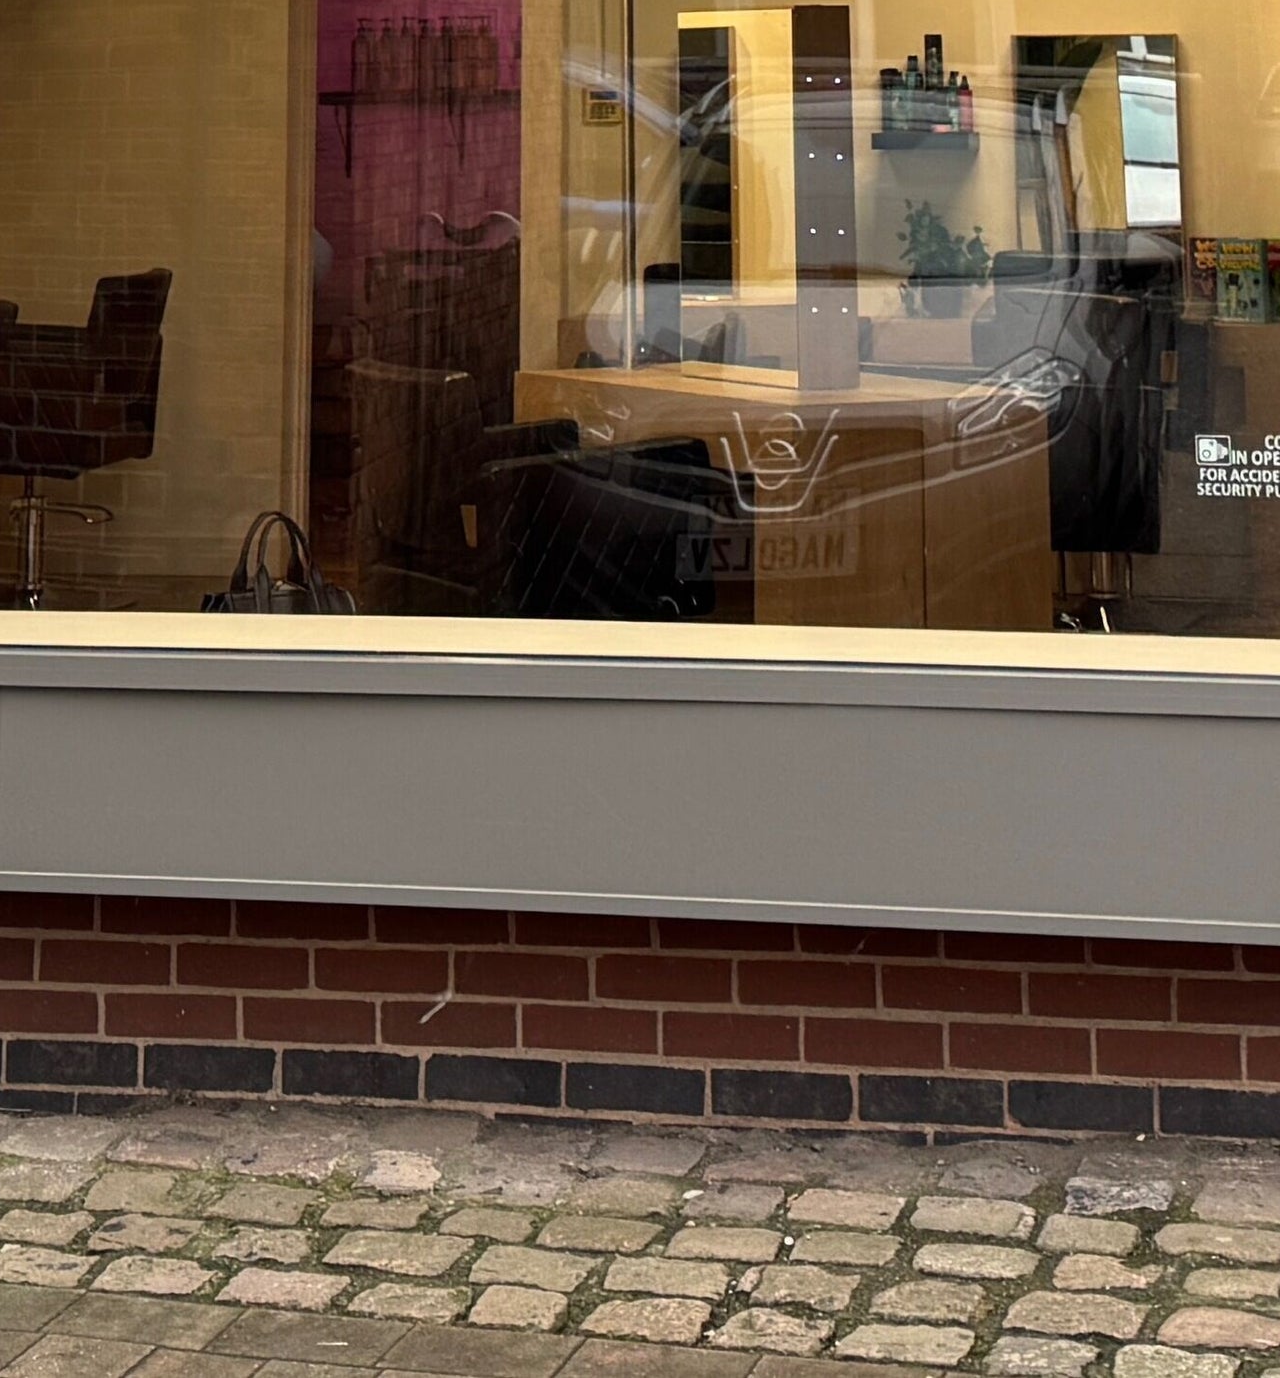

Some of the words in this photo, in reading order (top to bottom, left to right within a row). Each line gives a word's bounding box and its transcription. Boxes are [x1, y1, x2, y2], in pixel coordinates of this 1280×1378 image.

[1232, 450, 1248, 466] IN
[1199, 467, 1228, 482] FOR
[1196, 482, 1263, 498] SECURITY
